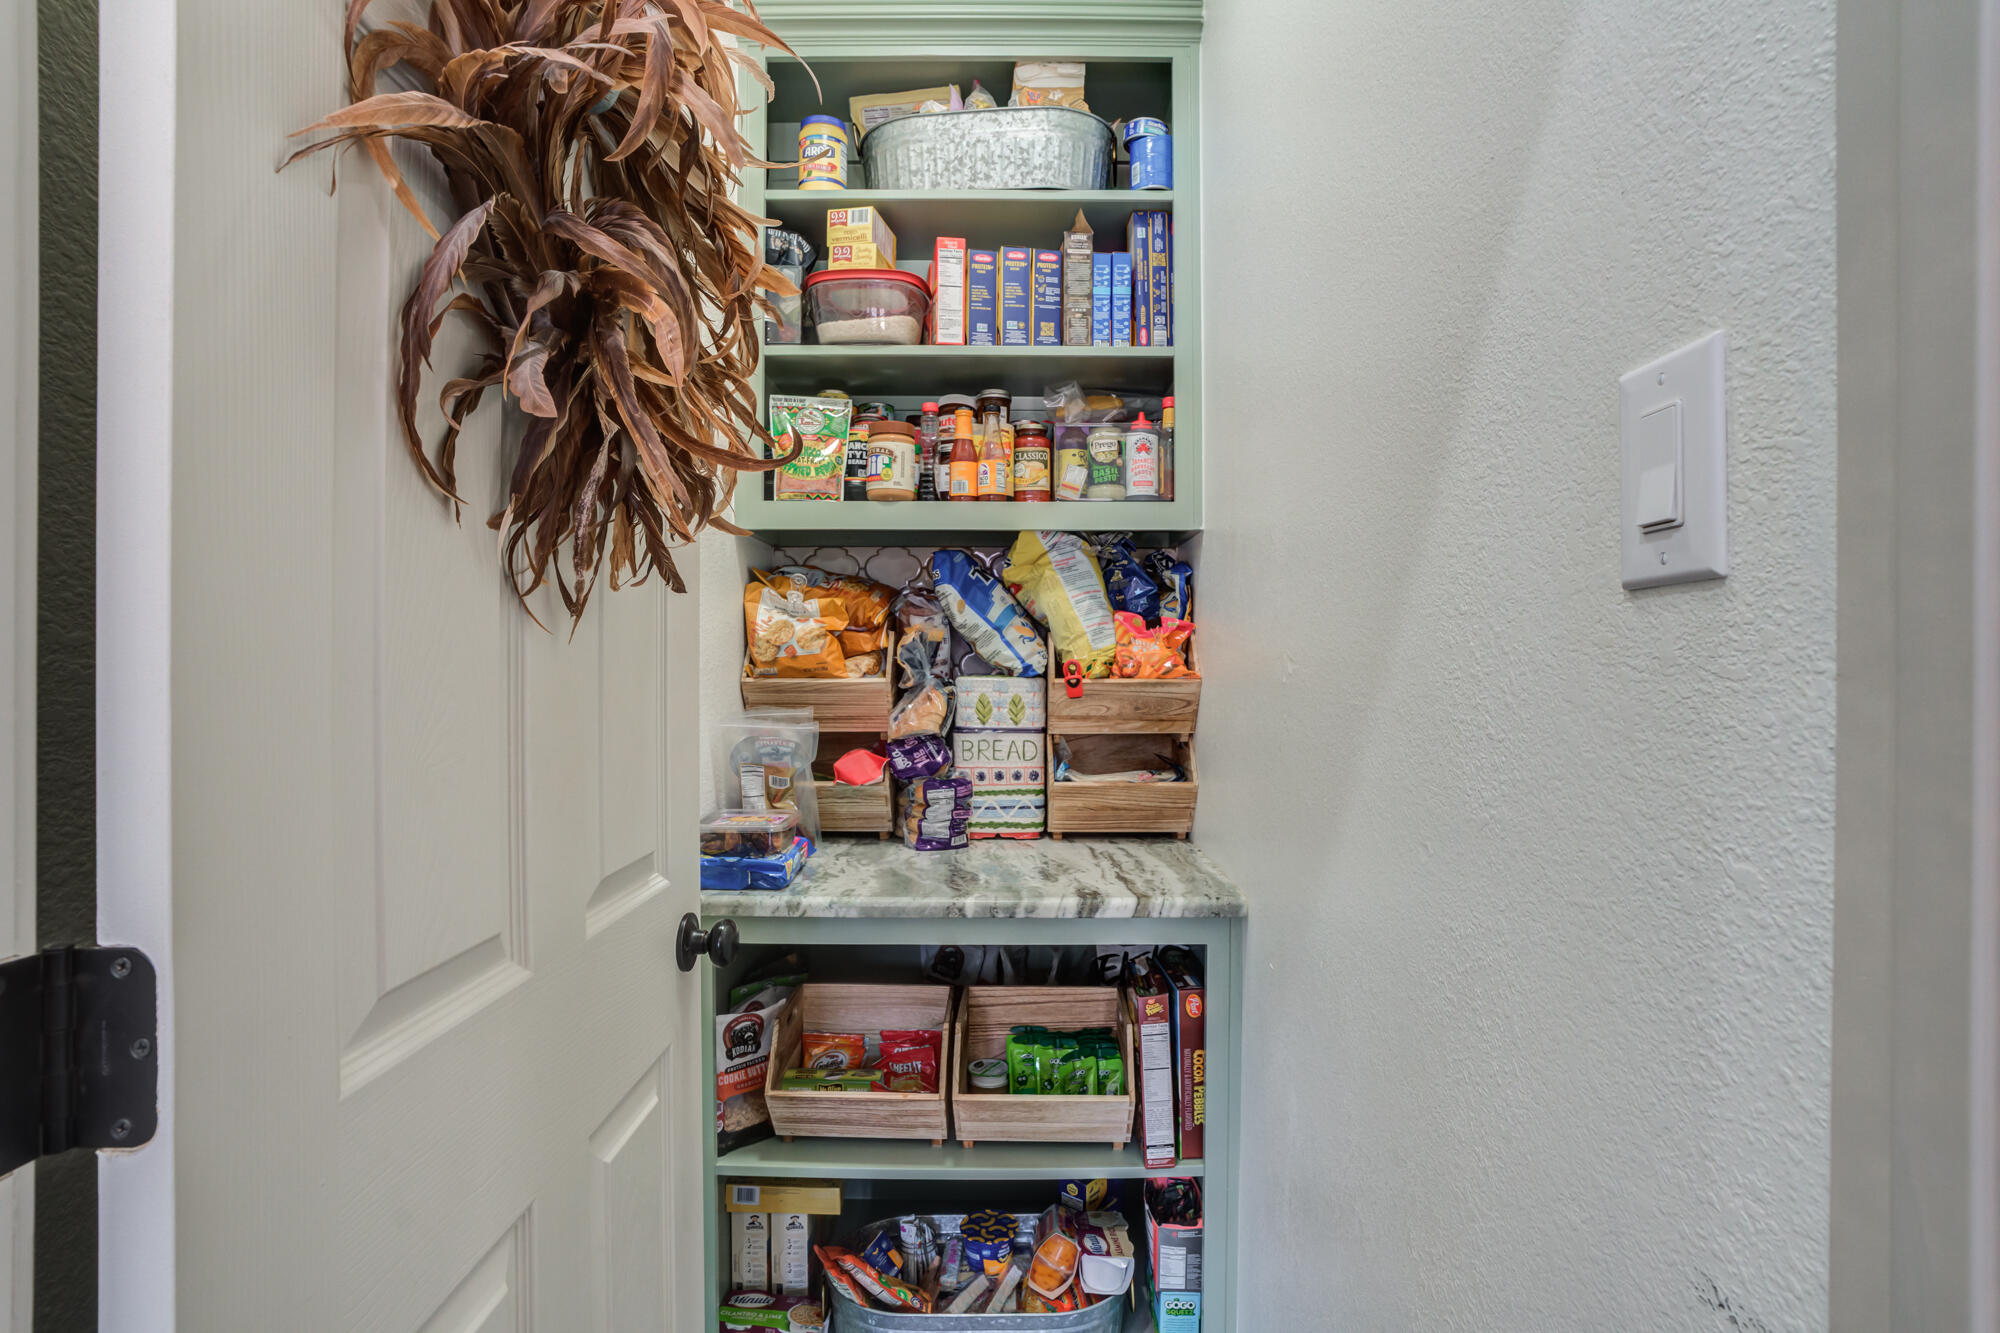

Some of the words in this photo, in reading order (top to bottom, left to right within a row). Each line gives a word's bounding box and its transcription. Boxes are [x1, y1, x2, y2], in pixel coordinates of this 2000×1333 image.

[1094, 441, 1117, 450] Prego
[848, 451, 868, 459] TYL
[1014, 451, 1048, 460] CLASSICO
[1093, 468, 1118, 478] BASIL
[961, 739, 1038, 761] BREAD
[1193, 1049, 1205, 1083] COCOA
[718, 1069, 747, 1087] COOKIE
[747, 1063, 769, 1077] BUTT
[1193, 1085, 1205, 1126] PEBBLES
[728, 1294, 776, 1306] Minute
[1164, 1300, 1196, 1310] GOGO
[720, 1309, 758, 1318] CILANTRO
